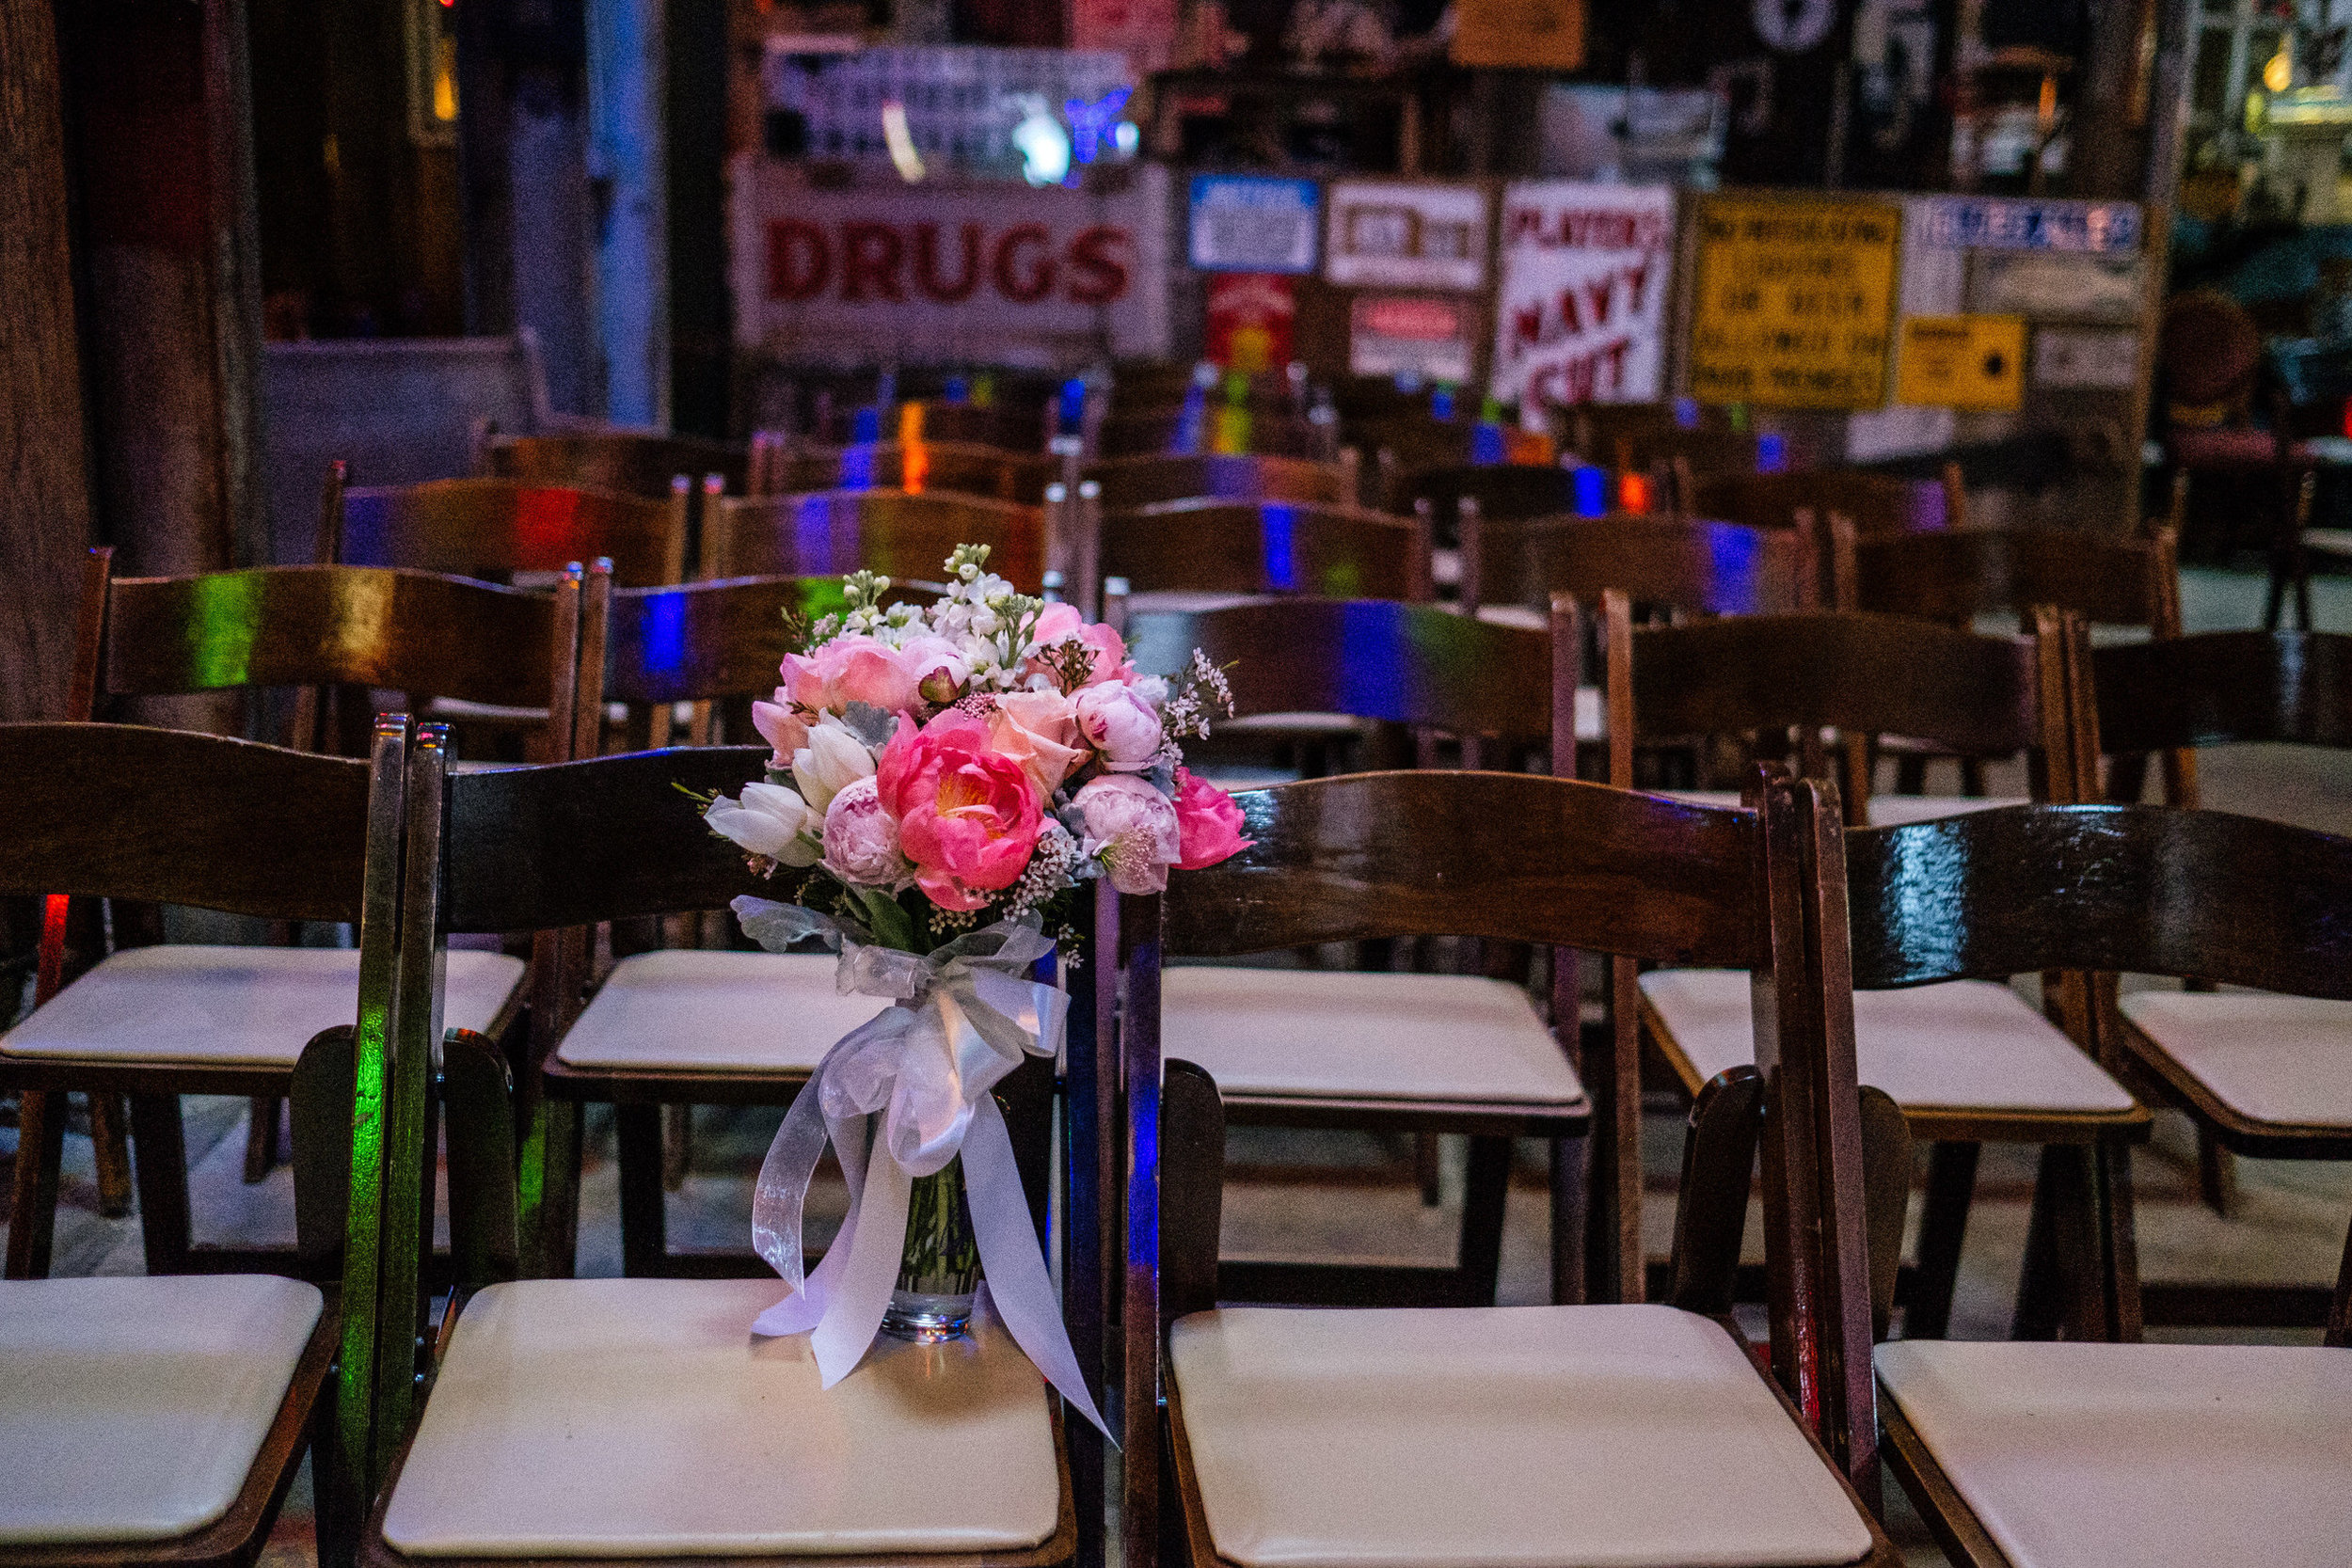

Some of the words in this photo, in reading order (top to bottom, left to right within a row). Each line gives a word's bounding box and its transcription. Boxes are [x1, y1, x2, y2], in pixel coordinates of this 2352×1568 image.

[764, 215, 1135, 305] DRUGS
[1511, 263, 1650, 358] NAVY
[1526, 336, 1633, 412] CUT
